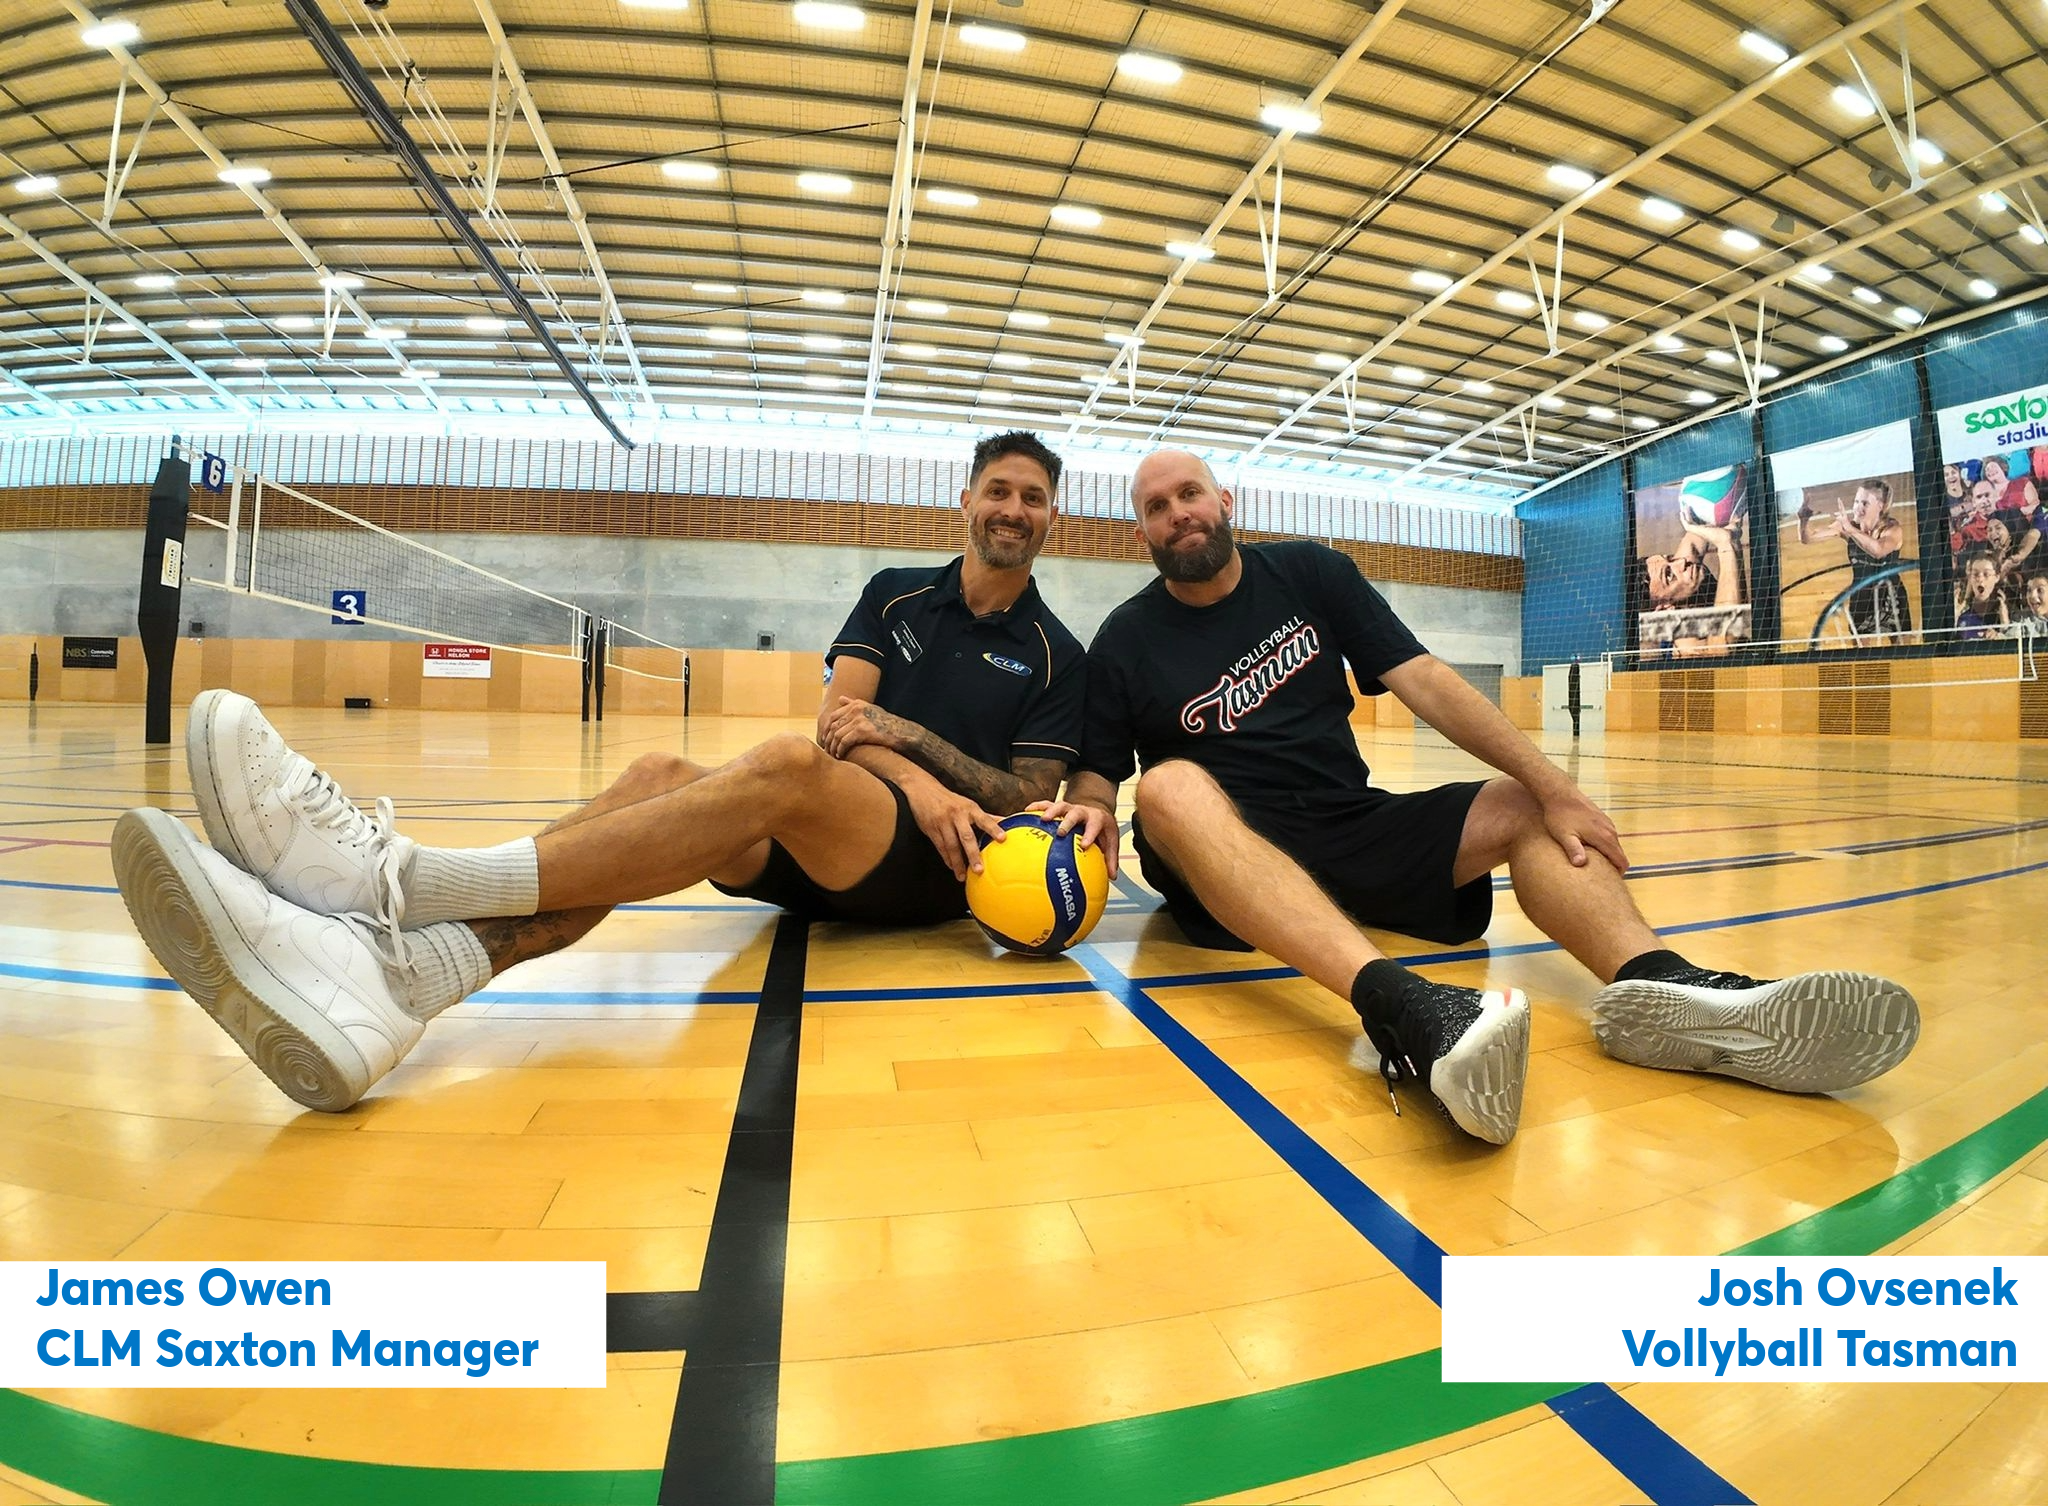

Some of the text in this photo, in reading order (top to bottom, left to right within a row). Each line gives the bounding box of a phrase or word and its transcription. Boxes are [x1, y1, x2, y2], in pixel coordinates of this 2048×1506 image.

[1964, 394, 2048, 434] saxto
[208, 458, 223, 488] 6
[339, 594, 358, 621] 3
[65, 647, 87, 658] NBS
[1229, 615, 1304, 677] VOLLEYBALL
[993, 656, 1026, 672] CLM
[1181, 624, 1320, 734] Tasman
